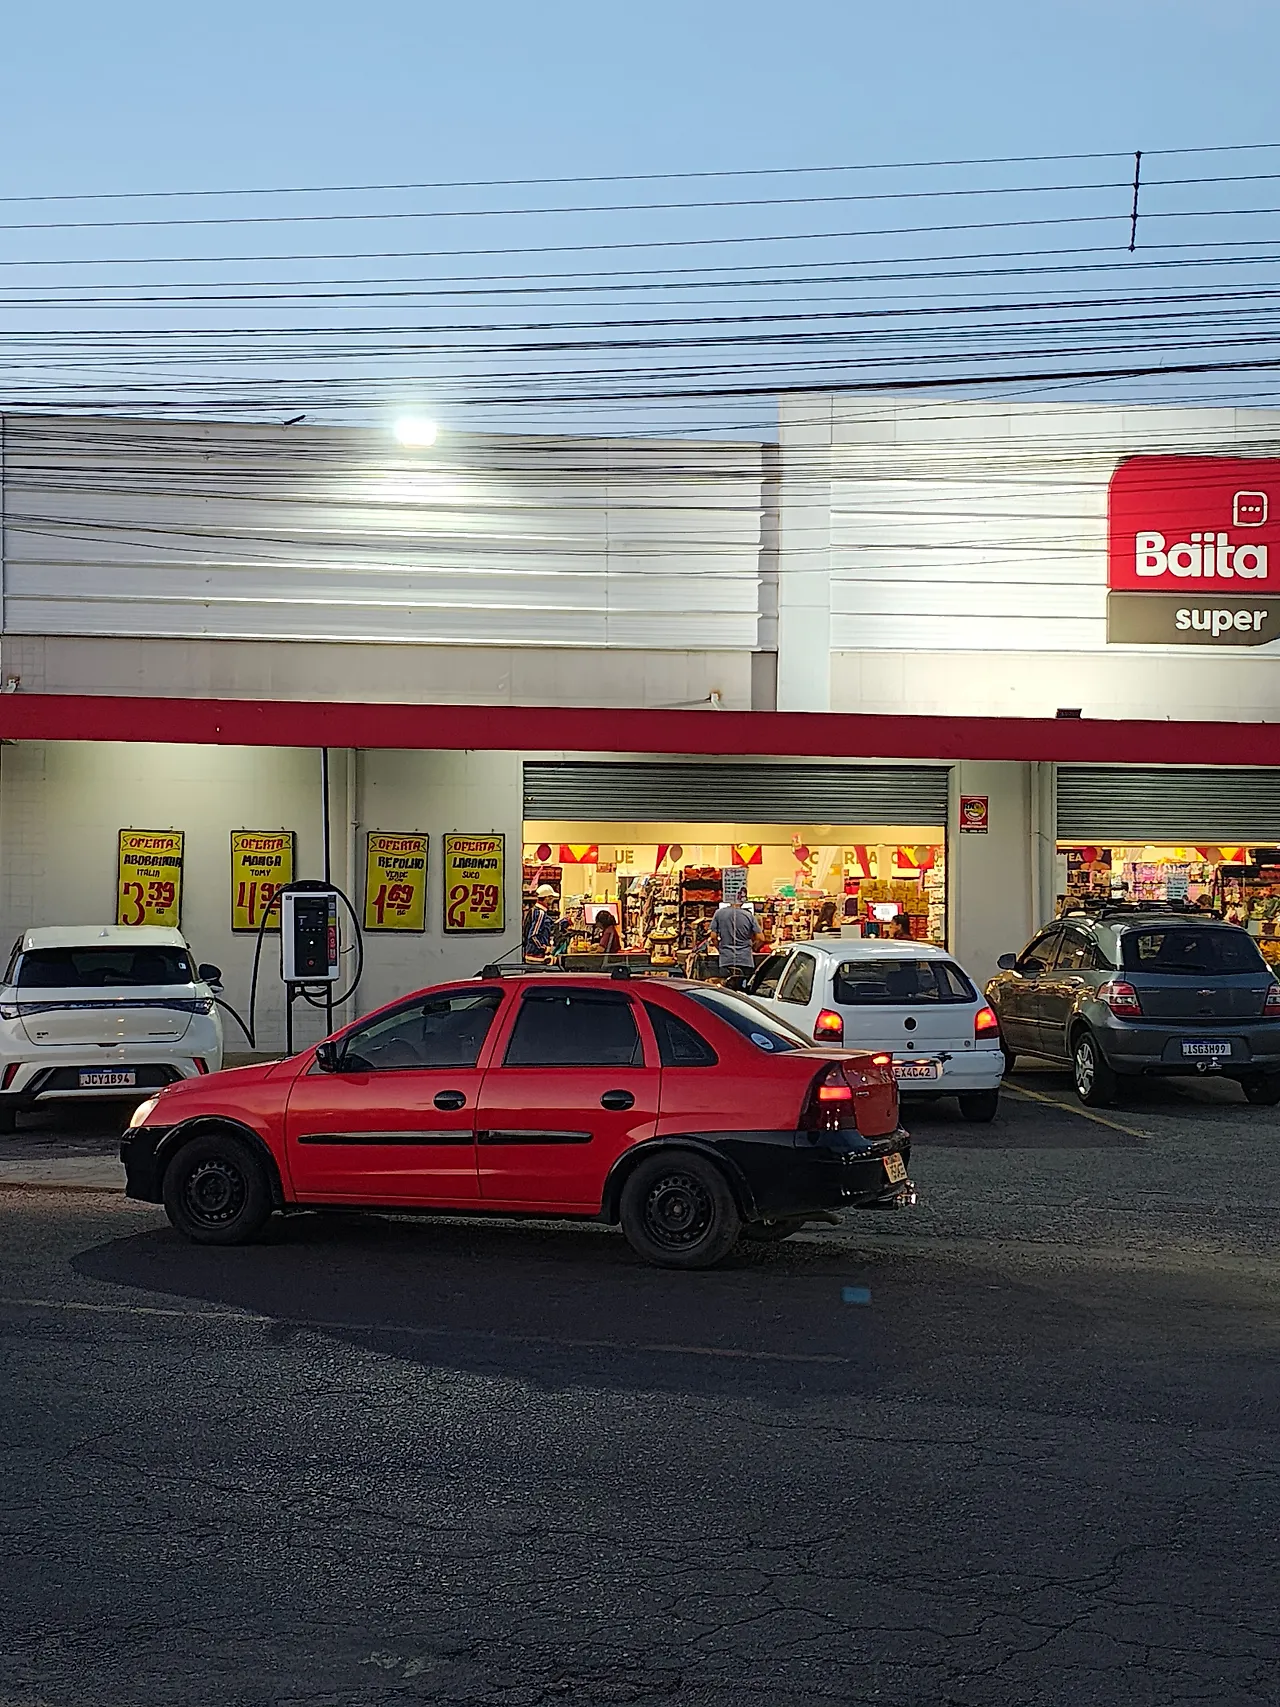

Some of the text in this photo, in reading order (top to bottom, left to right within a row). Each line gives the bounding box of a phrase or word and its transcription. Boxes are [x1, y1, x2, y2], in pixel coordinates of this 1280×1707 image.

[1175, 608, 1268, 637] super
[129, 838, 174, 849] OFERTA
[240, 838, 284, 849] OFERTA
[378, 839, 421, 851] OFERTA
[454, 841, 496, 851] OFERTA
[241, 855, 281, 867] MANGA
[378, 856, 425, 869] REPOLHO
[452, 857, 498, 869] LARANJA
[137, 868, 160, 877] ITALIA
[250, 869, 271, 877] TOMY
[462, 871, 480, 879] SUCO
[894, 1067, 931, 1078] EX4C42
[84, 1073, 131, 1085] JCY1B94
